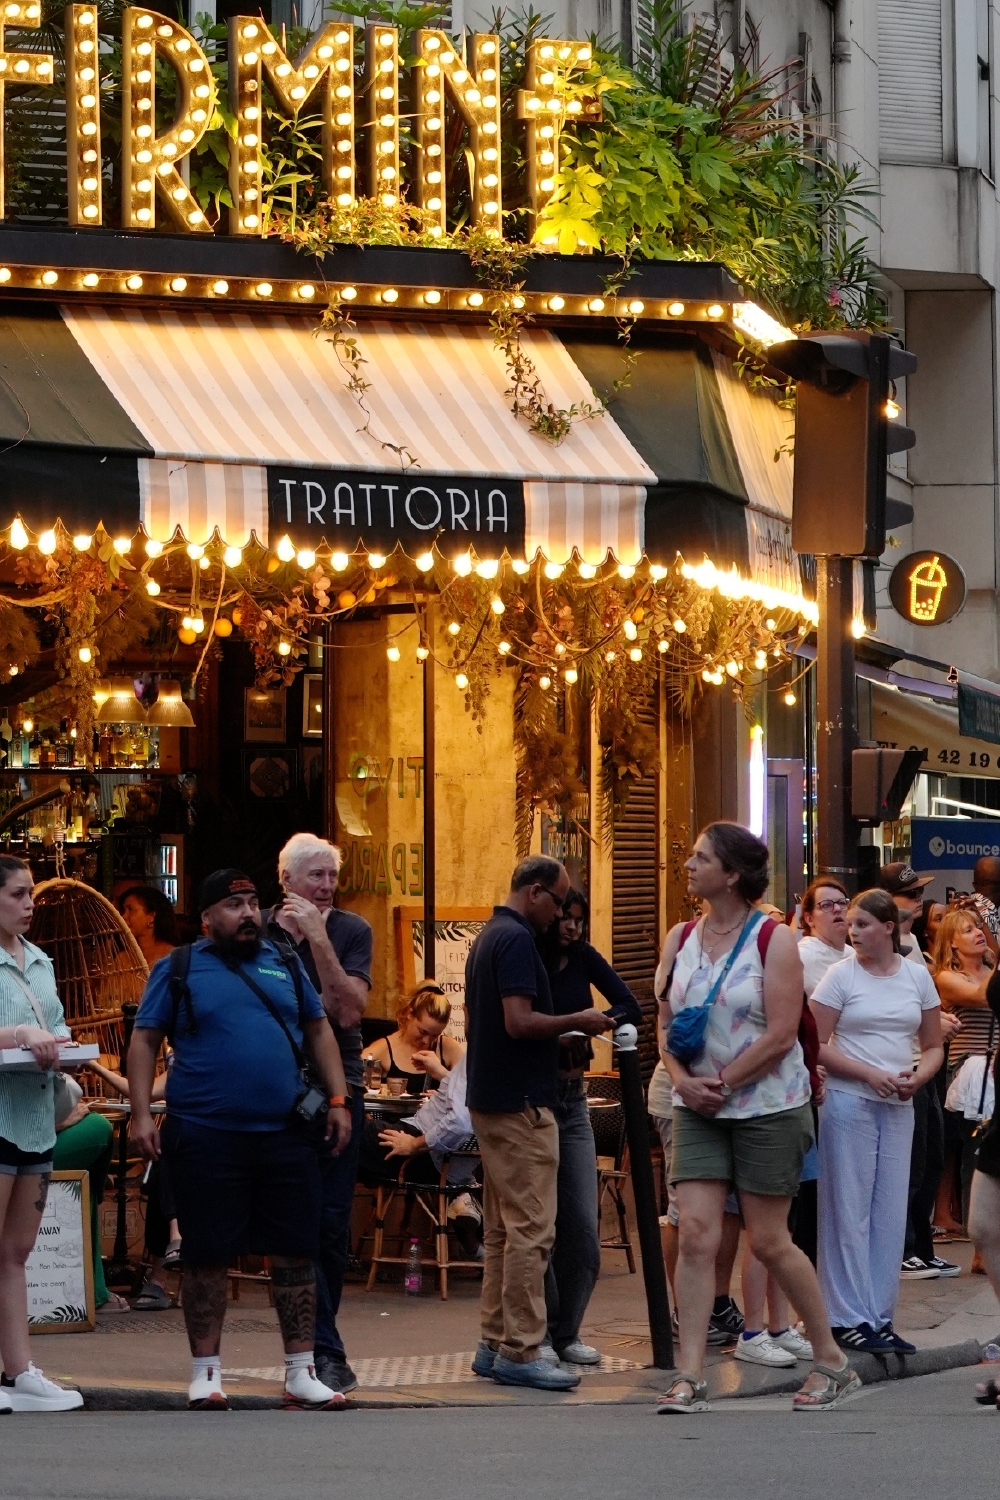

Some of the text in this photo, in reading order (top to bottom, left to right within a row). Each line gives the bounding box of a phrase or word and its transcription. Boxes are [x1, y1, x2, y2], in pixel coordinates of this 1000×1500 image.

[278, 479, 509, 533] TRATTORIA
[937, 749, 960, 765] 42
[968, 751, 991, 768] 19
[946, 839, 1000, 856] bounce
[439, 982, 466, 993] KITCH
[38, 1226, 61, 1236] AWAY
